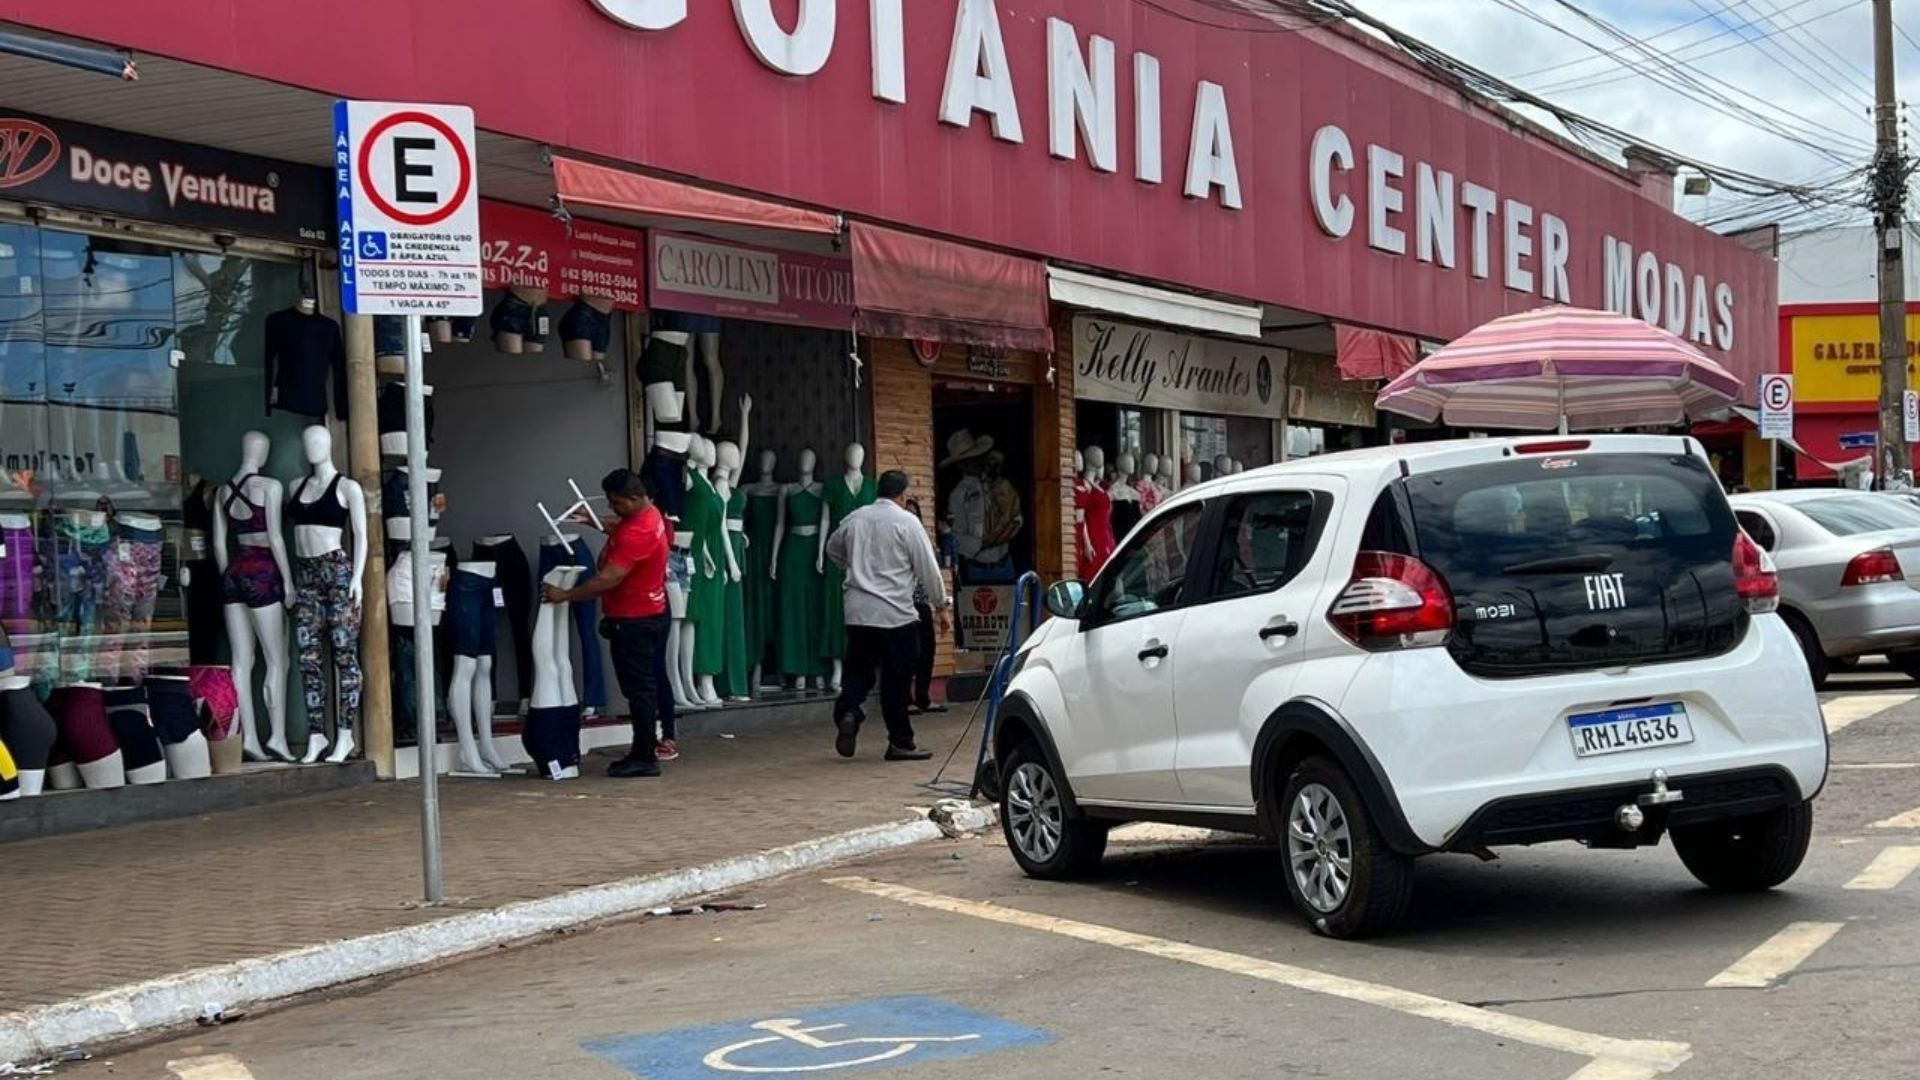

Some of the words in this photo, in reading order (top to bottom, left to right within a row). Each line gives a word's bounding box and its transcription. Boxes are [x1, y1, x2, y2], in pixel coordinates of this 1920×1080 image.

[69, 146, 151, 190] Doce
[336, 131, 350, 198] ÁREA
[393, 136, 438, 204] E
[341, 221, 353, 284] AZUL
[390, 232, 452, 241] OBRIGATÓRIO
[453, 234, 473, 242] USO
[404, 243, 461, 251] CREDENCIAL
[1310, 125, 1571, 303] CENTER
[1603, 235, 1734, 352] MODAS
[359, 269, 390, 278] TODOS
[392, 269, 405, 278] OS
[407, 270, 428, 278] DIAS
[372, 281, 407, 290] TEMPO
[454, 283, 466, 291] 2h
[500, 264, 550, 289] Deluxe
[658, 243, 776, 295] CAROLINY
[780, 259, 853, 305] VITÓRI
[398, 300, 425, 308] VAGA
[1079, 322, 1156, 403] Kelly
[1162, 339, 1250, 397] Arantes
[1771, 384, 1784, 405] E
[1583, 572, 1626, 610] FIAT
[1475, 604, 1516, 619] MOBI
[1581, 716, 1679, 751] RMI4G36
